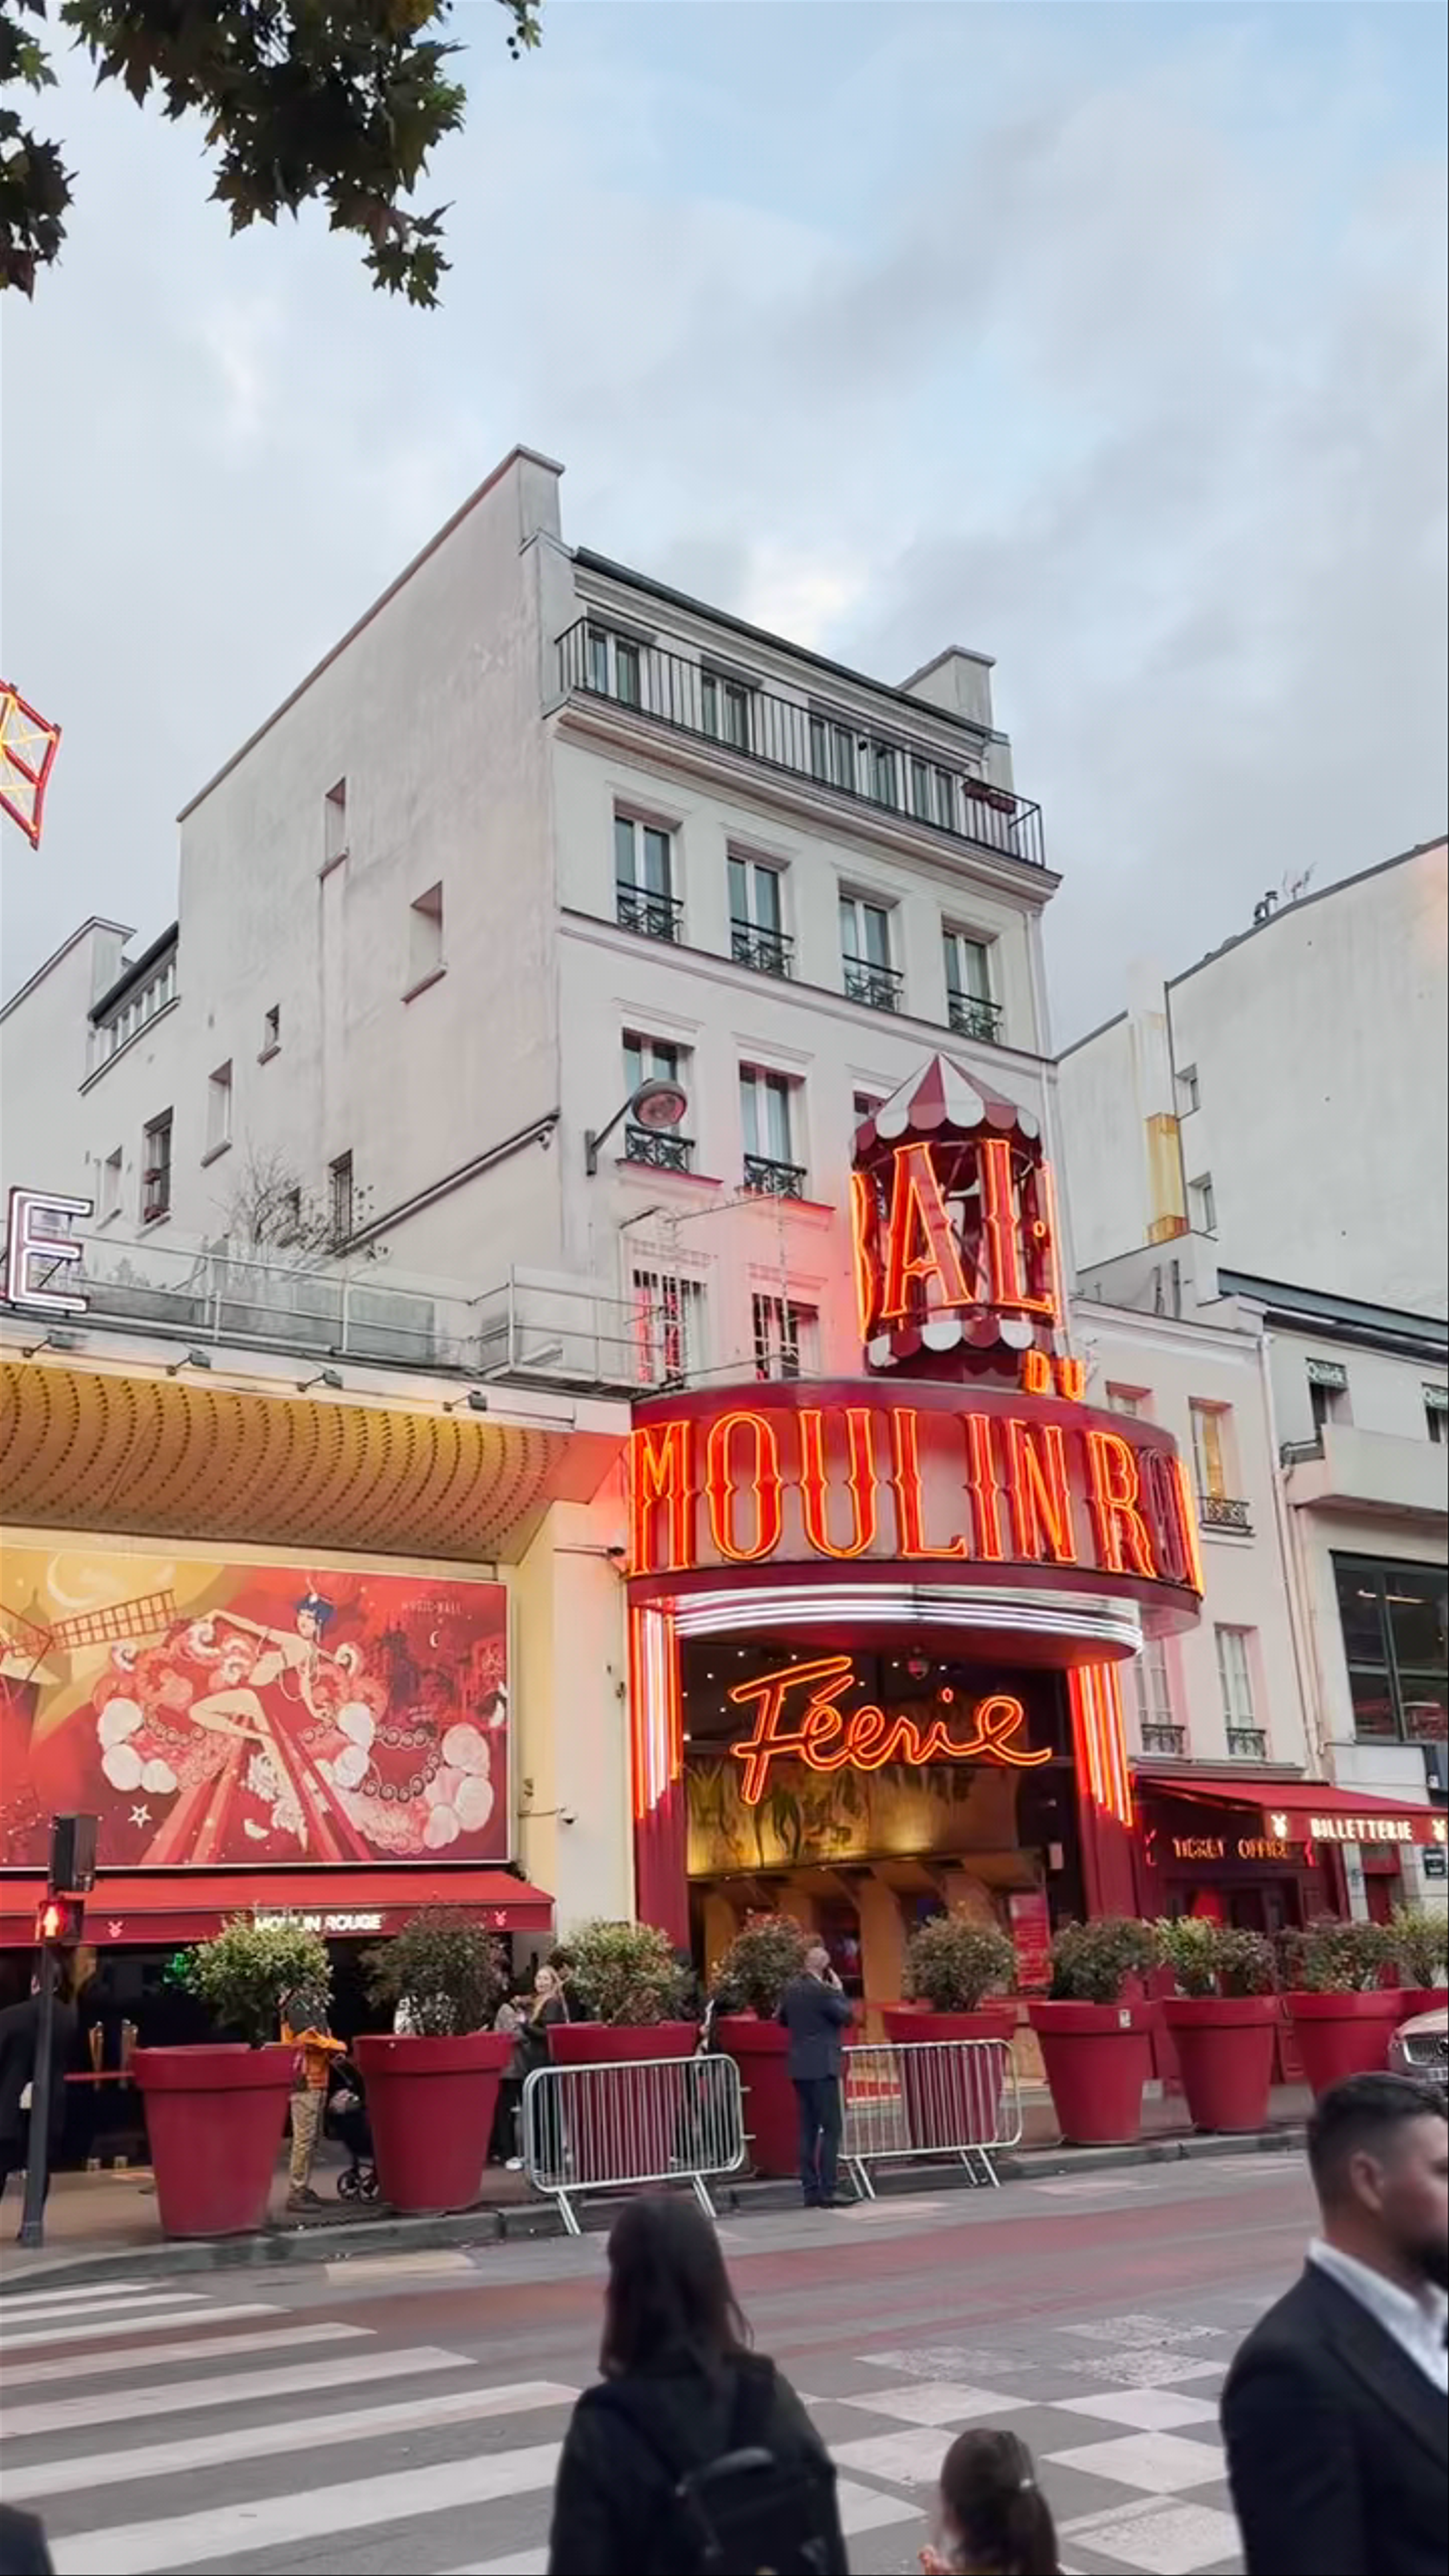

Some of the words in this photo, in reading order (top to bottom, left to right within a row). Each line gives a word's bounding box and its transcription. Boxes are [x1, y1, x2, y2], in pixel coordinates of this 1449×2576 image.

[1025, 1349, 1085, 1401] DU
[628, 1407, 1078, 1576] MOULIN
[731, 1655, 1052, 1805] Féerie
[1310, 1818, 1413, 1840] BILLETTERIE
[325, 1914, 383, 1931] ROUGE
